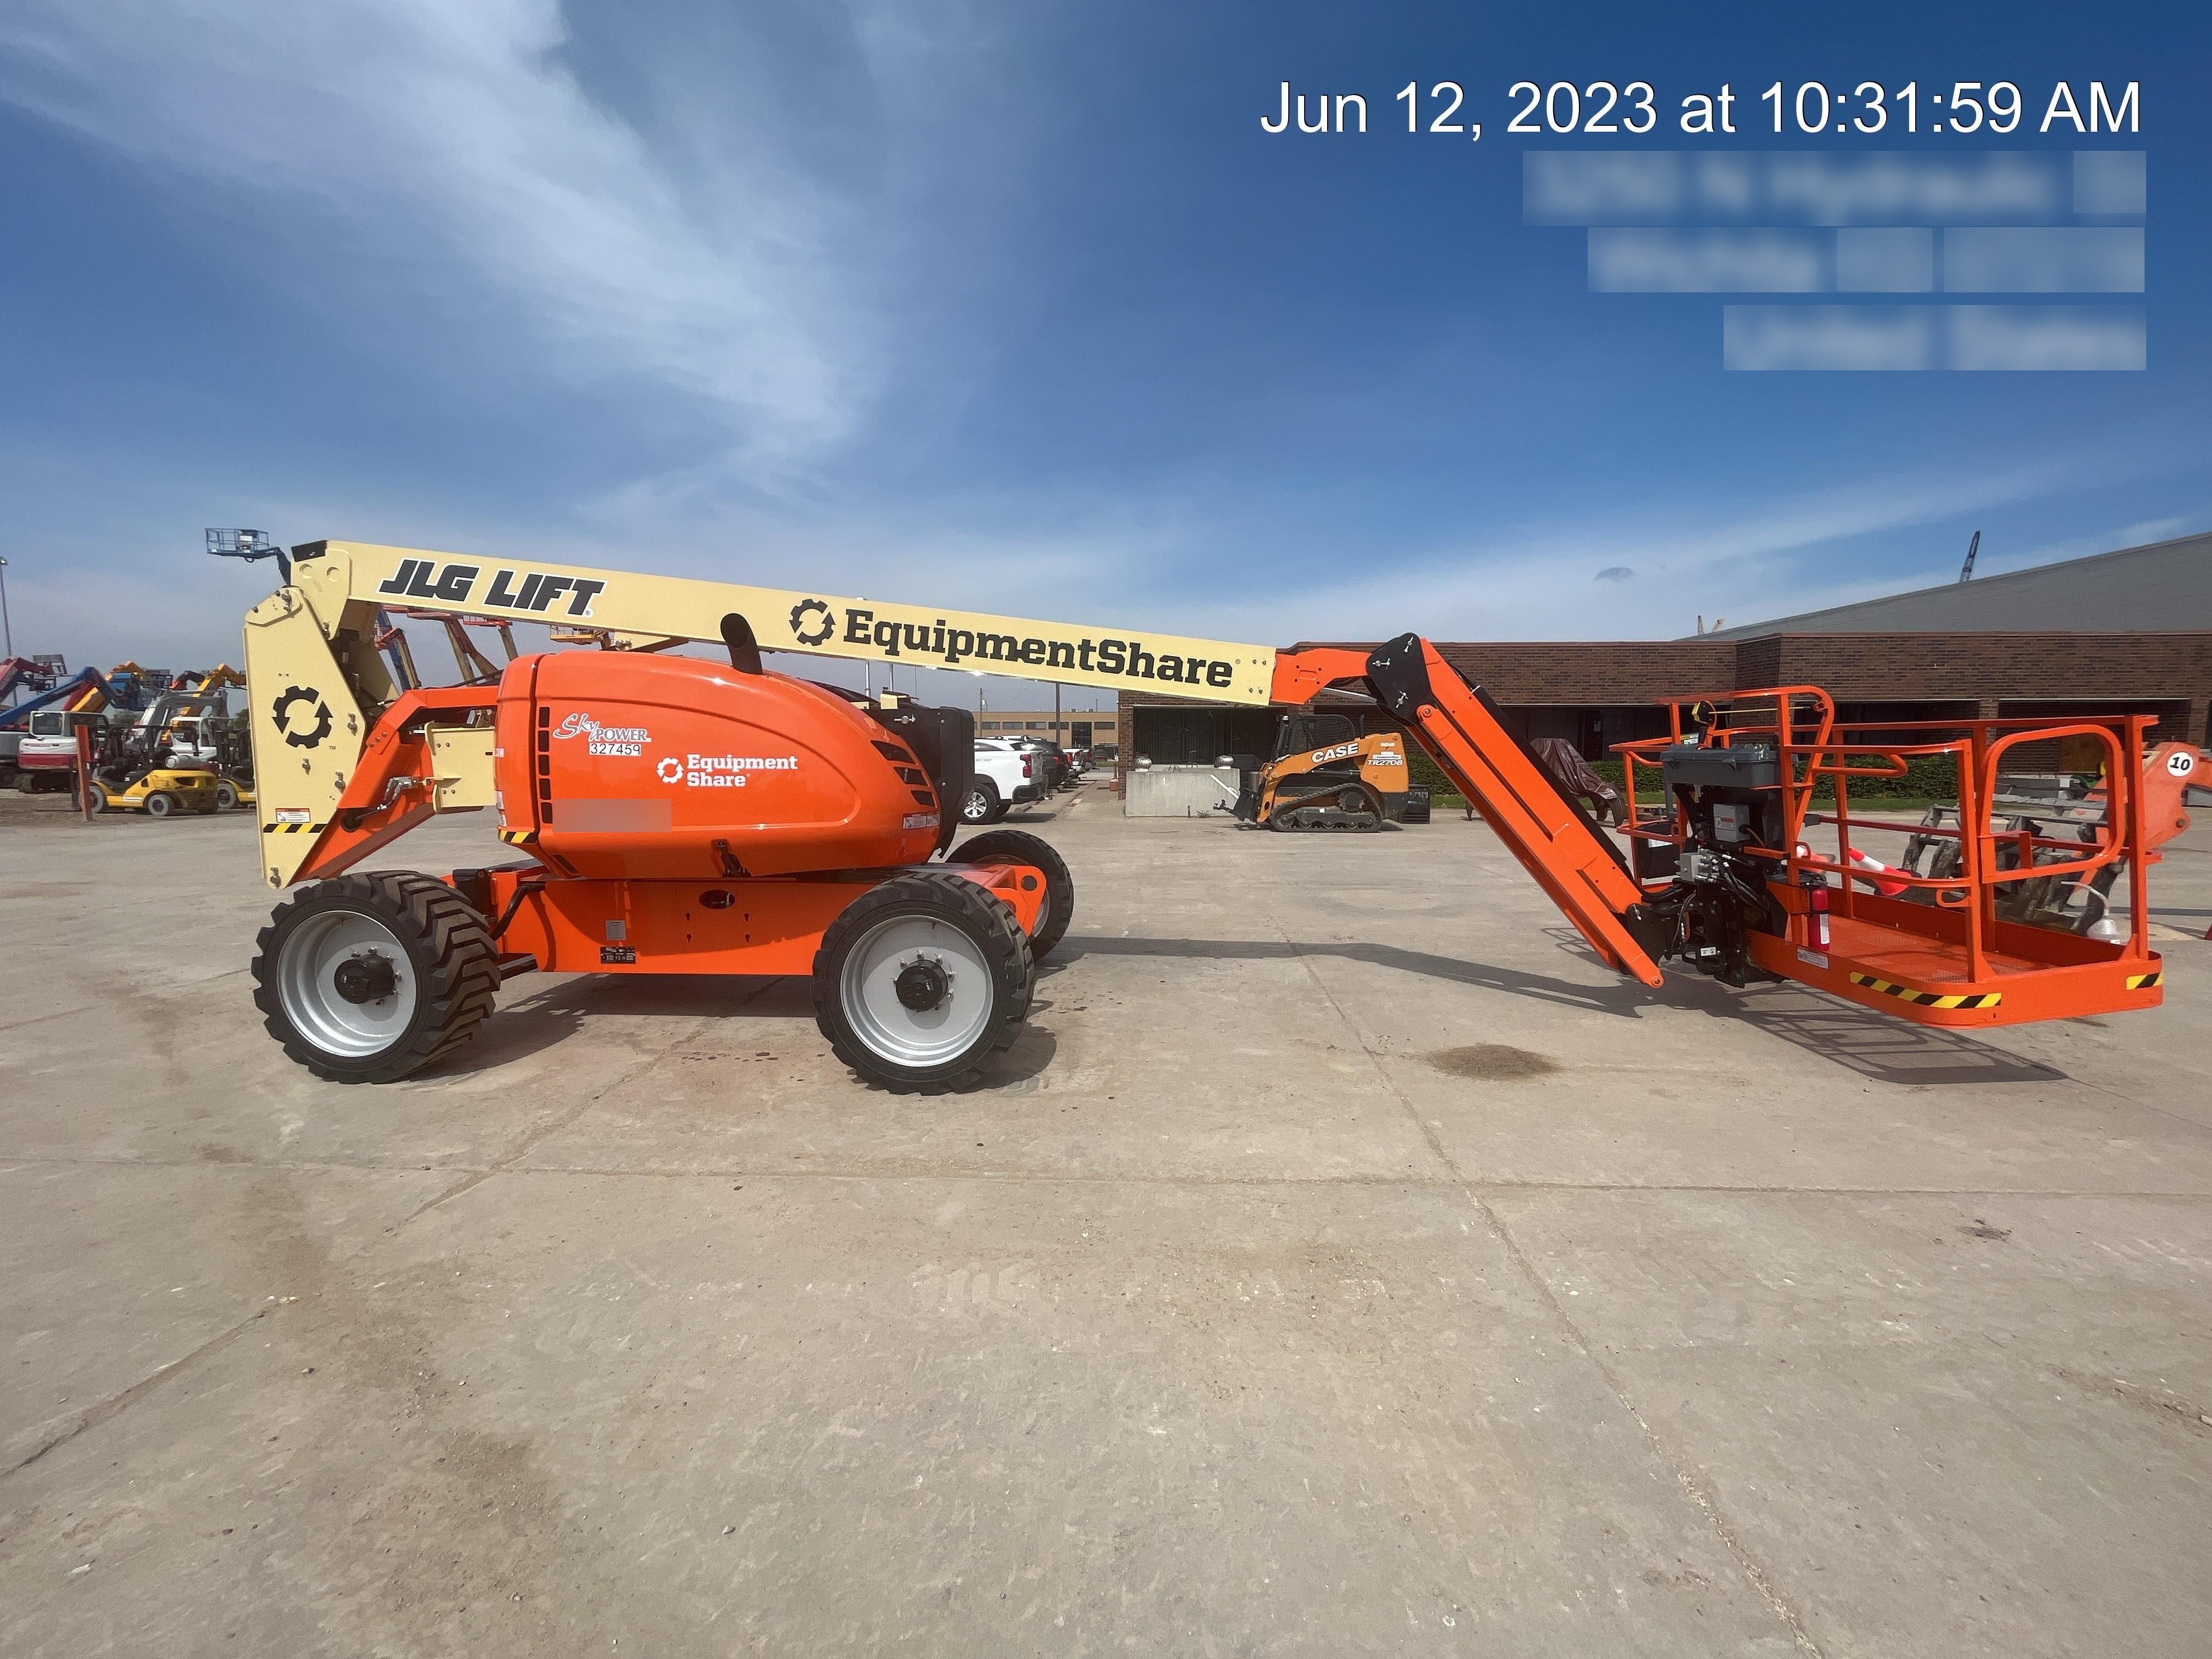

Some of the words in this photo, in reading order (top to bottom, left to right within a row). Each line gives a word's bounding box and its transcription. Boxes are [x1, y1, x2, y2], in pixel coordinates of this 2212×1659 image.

[379, 558, 480, 602] JLG
[483, 569, 606, 616] LIFT
[843, 608, 1233, 688] EquipmentShare
[590, 743, 641, 755] 327459
[1311, 742, 1359, 763] CASE
[686, 754, 798, 772] Equipment
[2169, 757, 2191, 771] 10
[686, 771, 747, 787] Share
